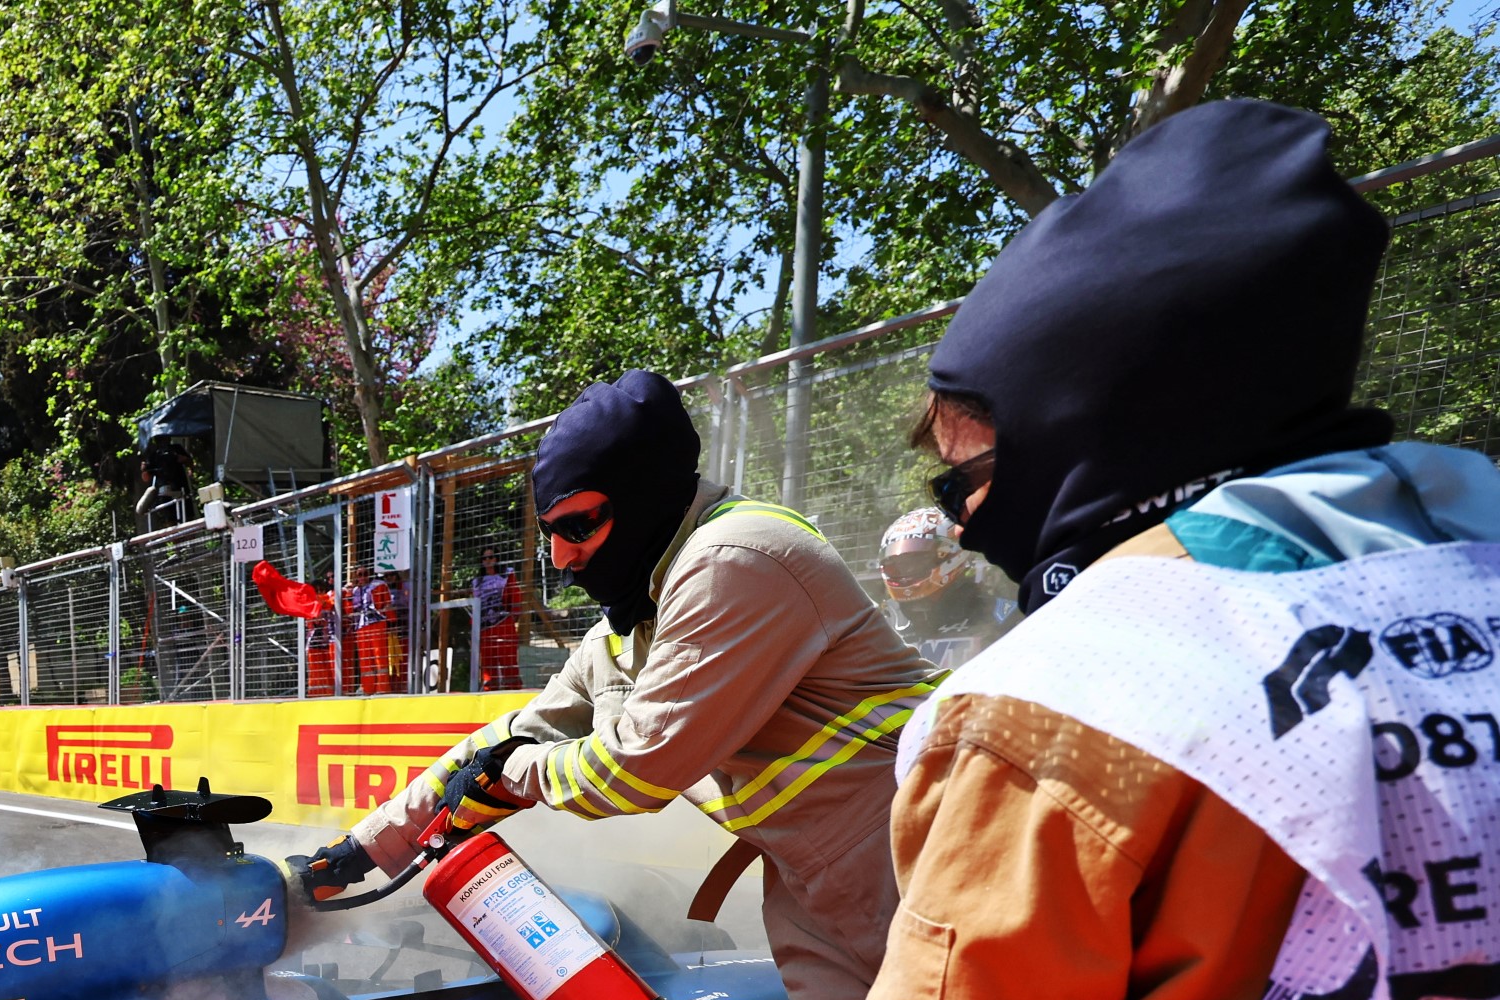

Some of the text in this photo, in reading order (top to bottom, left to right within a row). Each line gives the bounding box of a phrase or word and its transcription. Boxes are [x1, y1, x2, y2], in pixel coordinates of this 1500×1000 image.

[236, 538, 257, 550] 12.0
[1382, 622, 1489, 670] FIA
[46, 725, 174, 790] PIRELLI
[459, 871, 493, 903] KÖPÜKLÜ
[494, 857, 515, 872] FOAM
[482, 886, 509, 908] FIRE
[507, 870, 536, 889] GROU
